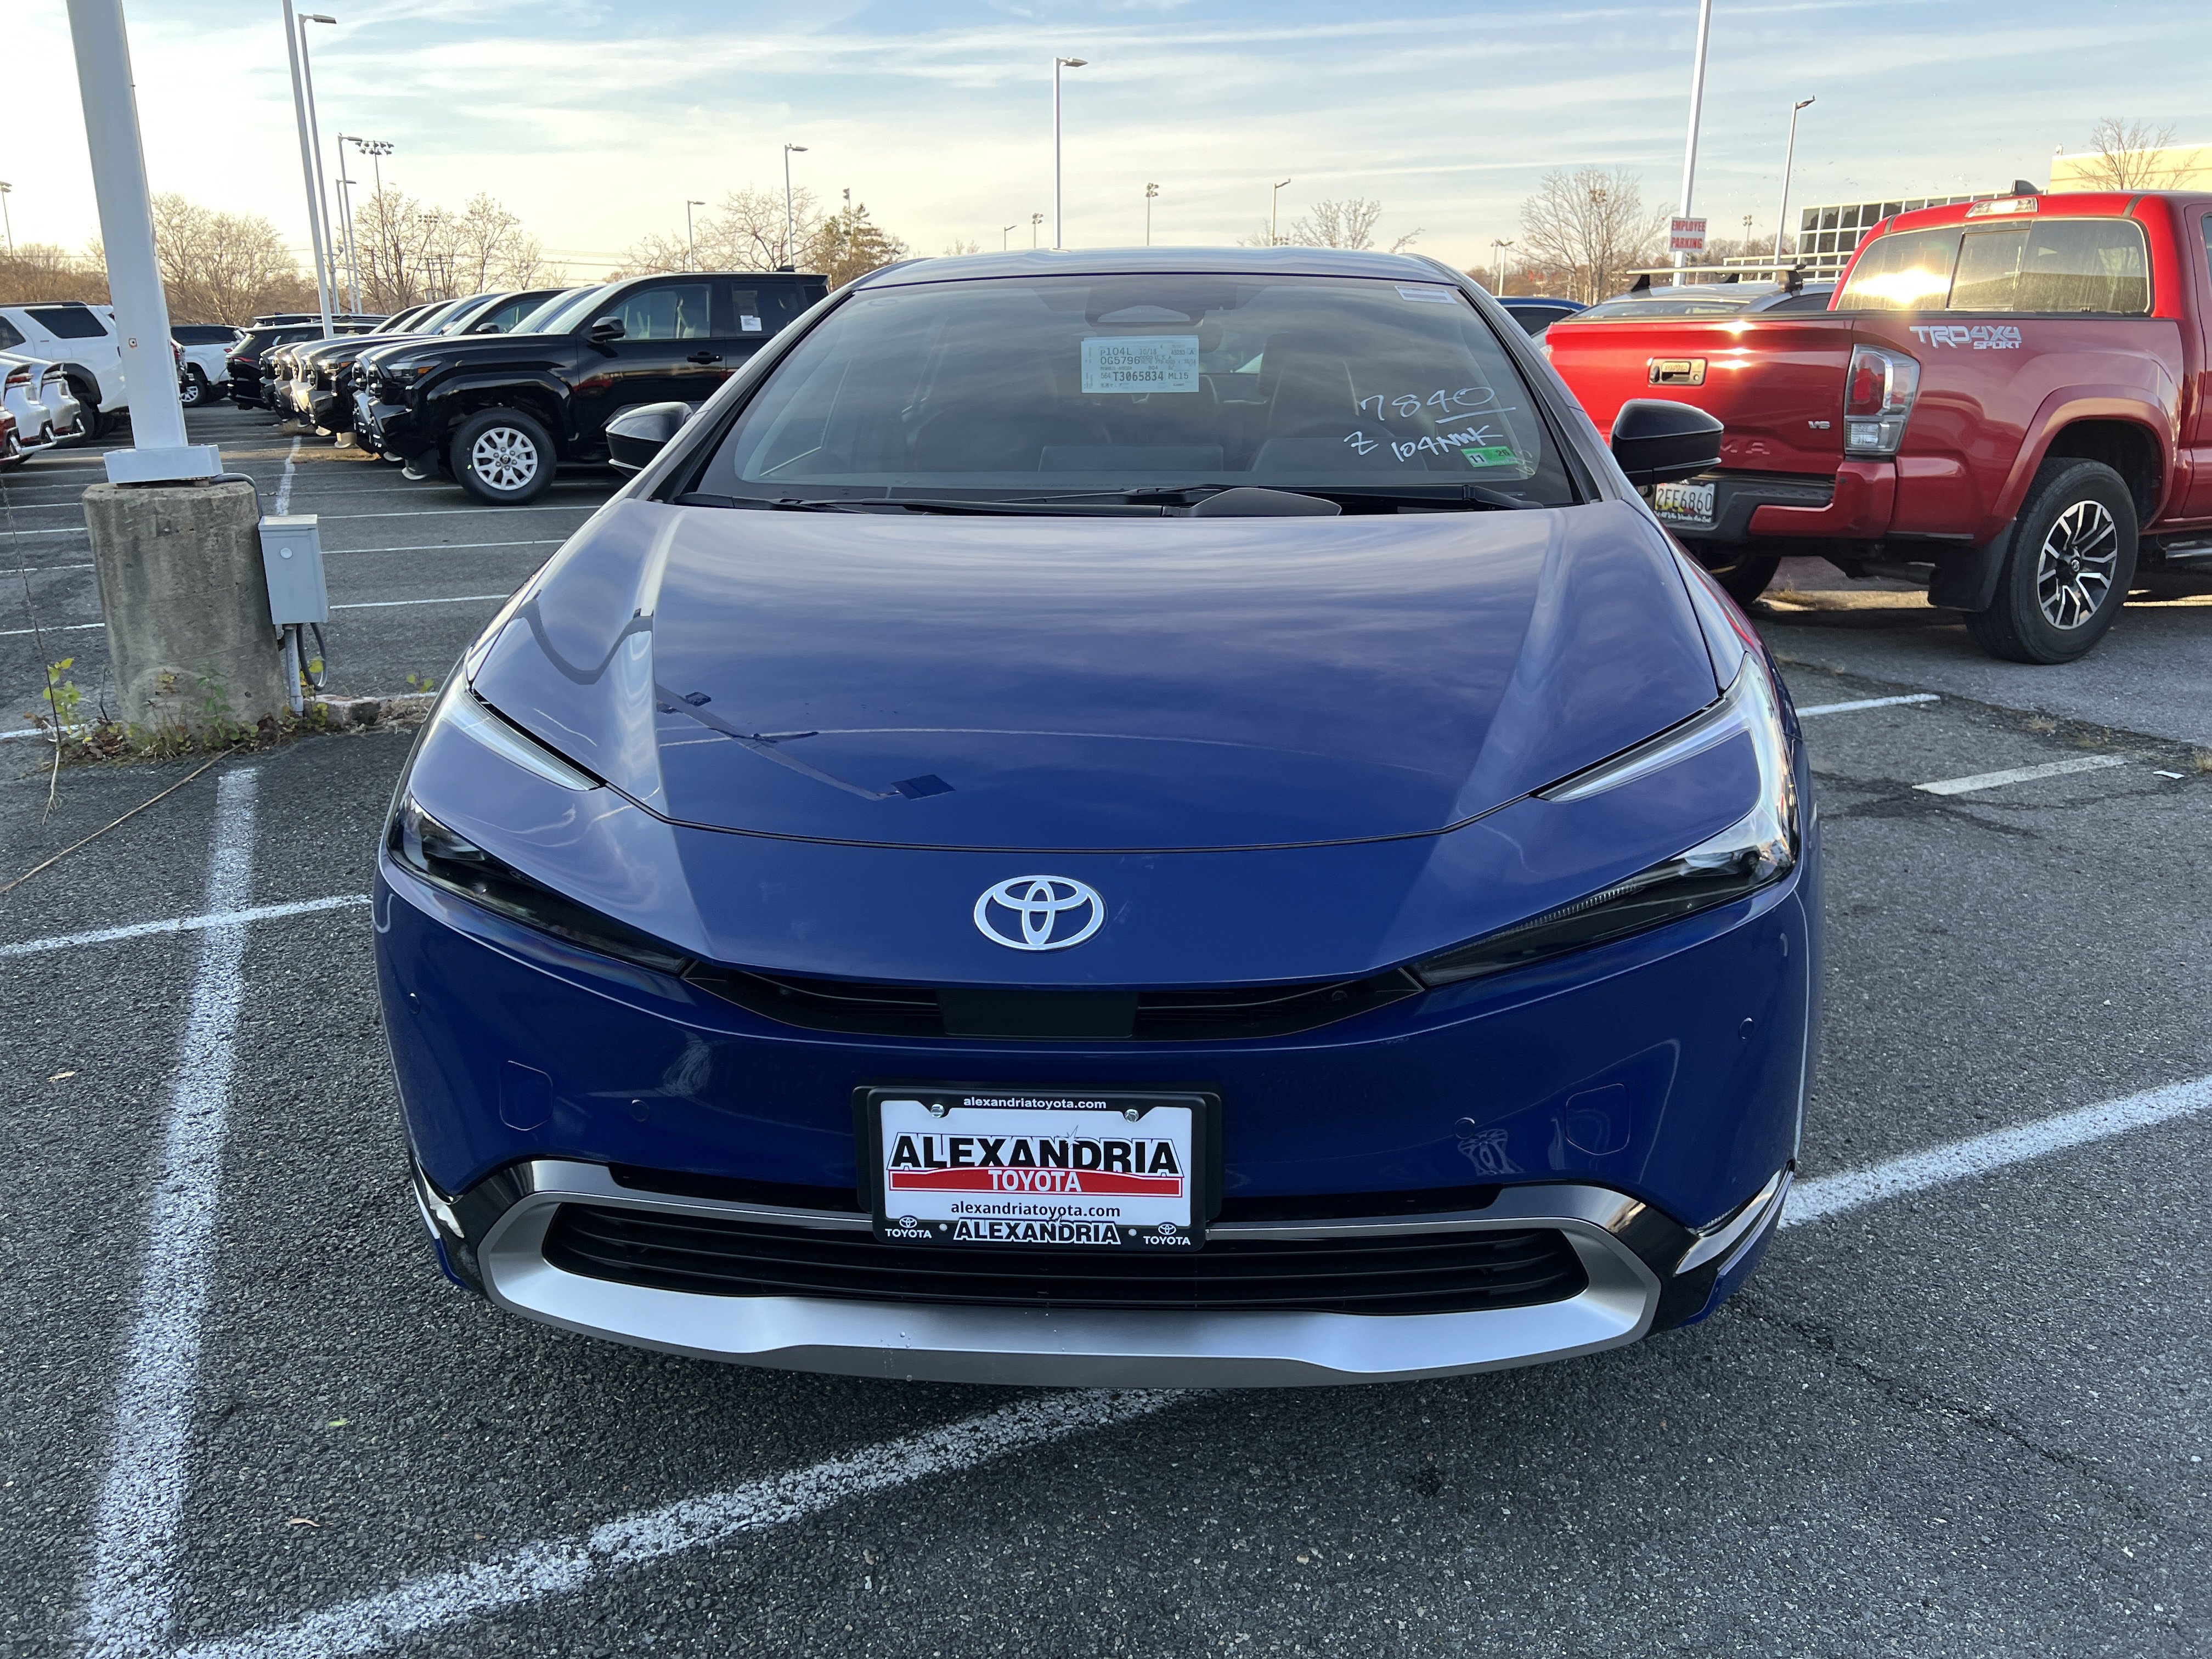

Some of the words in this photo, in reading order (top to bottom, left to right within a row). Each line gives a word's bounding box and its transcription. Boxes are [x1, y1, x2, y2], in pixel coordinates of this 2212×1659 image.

[1672, 220, 1706, 232] EMPLOYEE
[1671, 237, 1703, 249] PARKING
[1909, 325, 1972, 349] TRD
[1973, 340, 2022, 349] SPORT
[1113, 371, 1164, 381] T3065834
[1361, 387, 1495, 421] 7840
[1808, 421, 1830, 429] V6
[1469, 454, 1485, 463] 11
[964, 1097, 1107, 1110] alexandriatoyota.com
[889, 1133, 1181, 1175] ALEXANDRIA
[988, 1169, 1082, 1192] TOYOTA
[951, 1200, 1120, 1218] alexandriatoyota.com
[885, 1228, 932, 1238] TOYOTA
[954, 1218, 1121, 1244] ALEXANDRIA
[1143, 1235, 1190, 1245] TOYOTA
